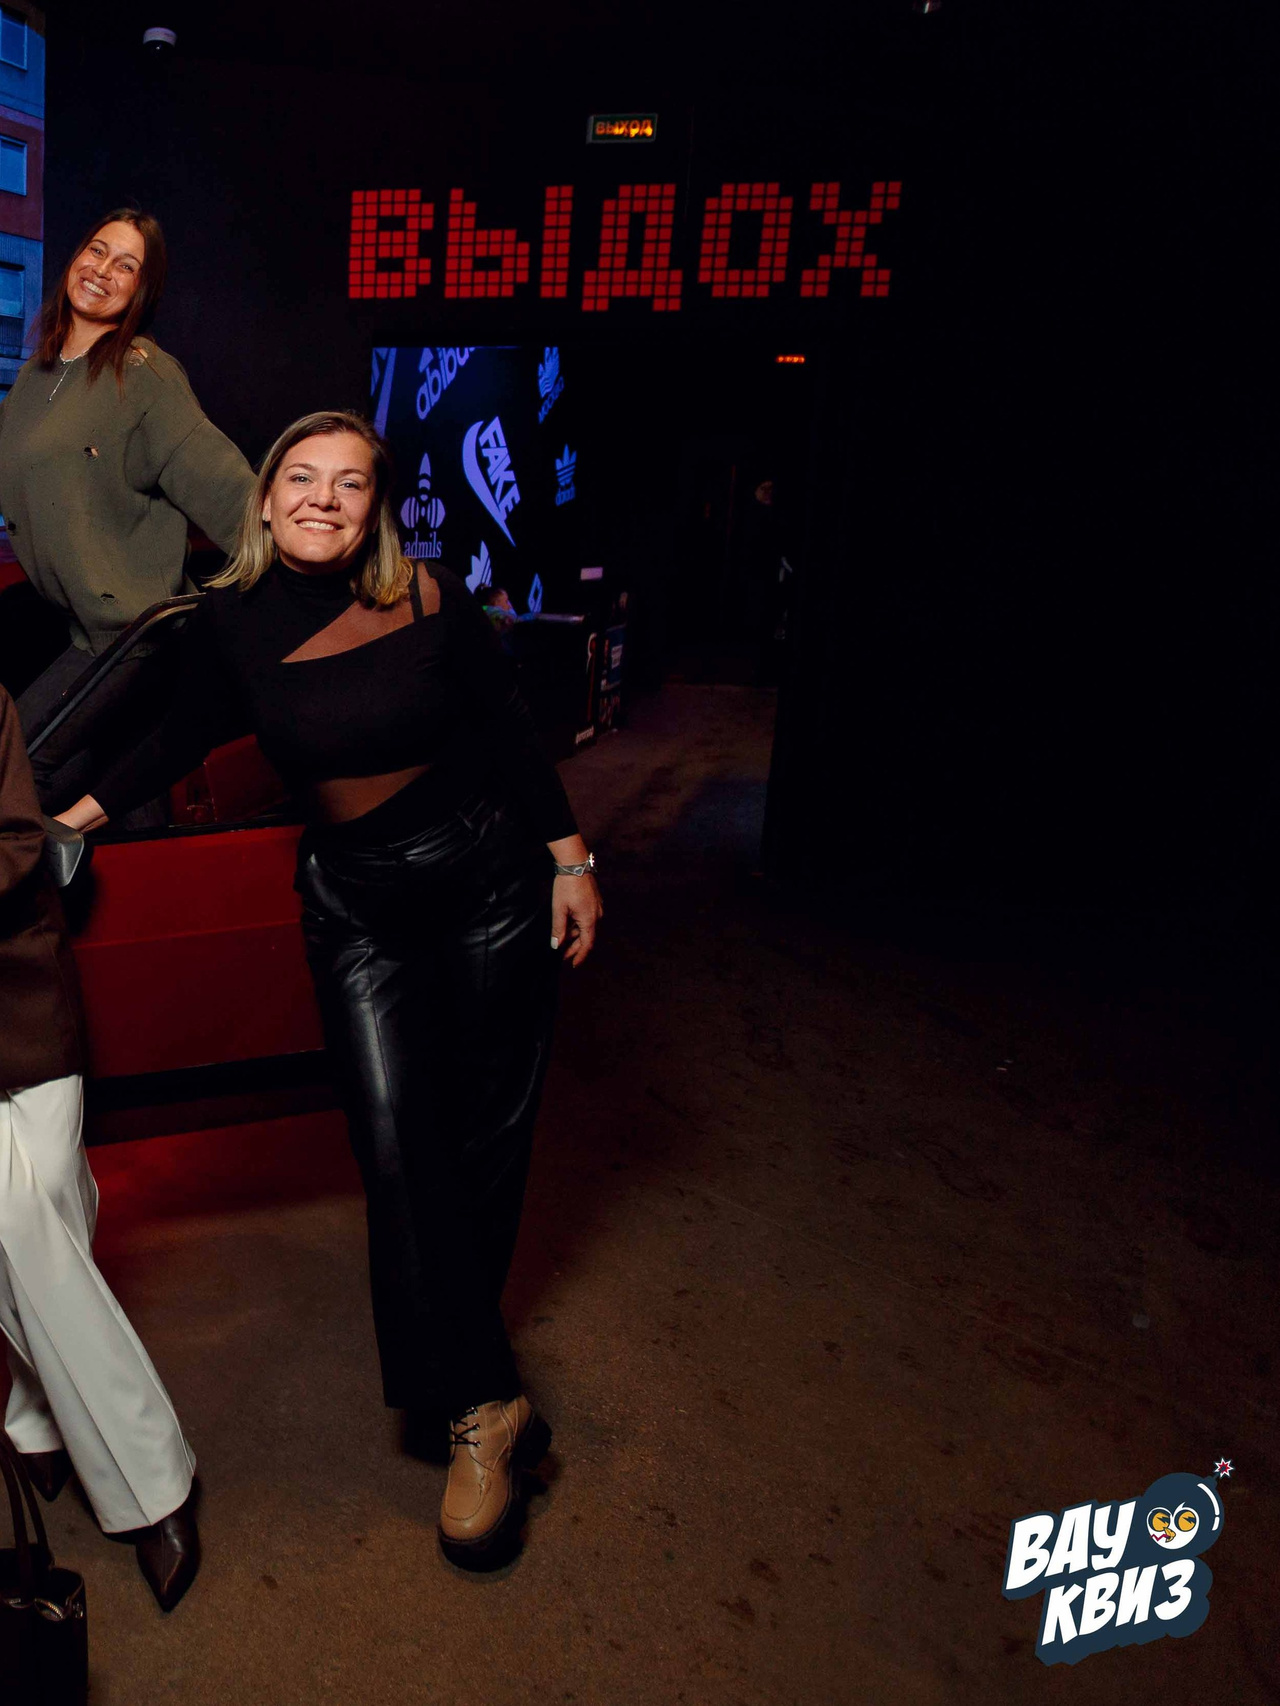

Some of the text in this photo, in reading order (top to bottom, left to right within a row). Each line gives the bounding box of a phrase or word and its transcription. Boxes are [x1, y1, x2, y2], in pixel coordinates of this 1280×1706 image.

[595, 119, 653, 137] ВЫХОД
[348, 180, 903, 312] ВЫДОХ
[478, 415, 521, 521] FAKE
[403, 530, 443, 559] admils
